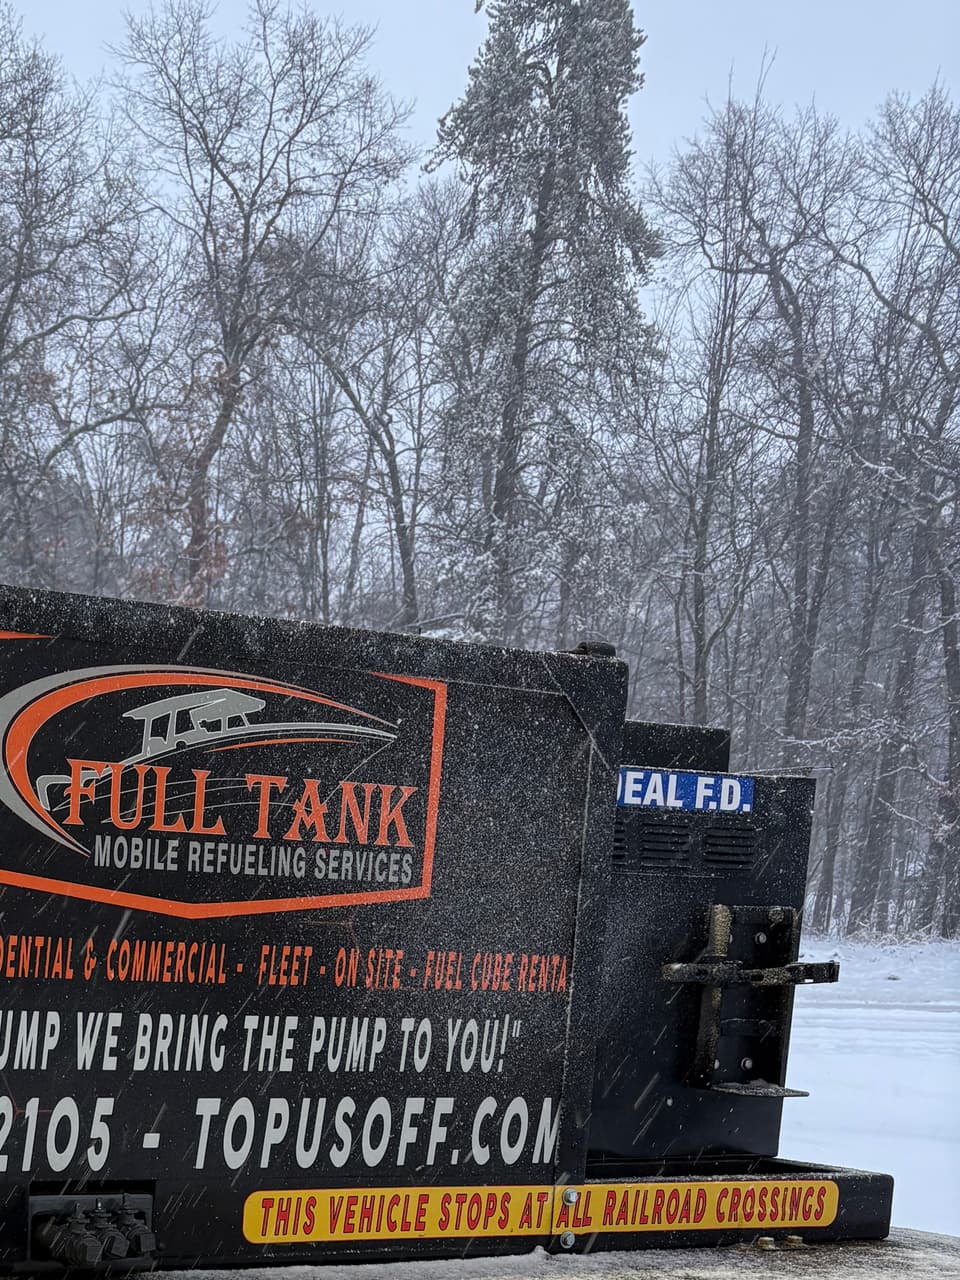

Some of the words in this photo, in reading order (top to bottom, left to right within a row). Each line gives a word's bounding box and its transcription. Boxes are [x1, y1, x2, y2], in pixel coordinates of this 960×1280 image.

[63, 758, 227, 836] FULL
[245, 773, 418, 848] TANK
[617, 771, 683, 808] EAL
[695, 776, 751, 812] F.D.
[93, 834, 179, 872] MOBILE
[187, 840, 306, 879] REFUELING
[314, 849, 413, 884] SERVICES
[83, 938, 97, 981] &
[106, 937, 227, 984] COMMERCIAL
[258, 944, 313, 987] FLEET
[334, 949, 360, 987] ON
[367, 948, 403, 990] SITE
[423, 951, 462, 992] FUEL
[471, 952, 513, 991] CUBE
[76, 1012, 123, 1071] WE
[133, 1013, 228, 1073] BRING
[242, 1015, 299, 1072] THE
[307, 1016, 387, 1073] PUMP
[400, 1017, 432, 1073] TO
[445, 1014, 521, 1073] YOU!"
[194, 1096, 561, 1169] TOPUSOFF.COM
[261, 1195, 317, 1237] THIS
[329, 1194, 429, 1233] VEHICLE
[440, 1192, 512, 1231] STOPS
[519, 1191, 548, 1230] AT
[556, 1190, 592, 1228] ALL
[602, 1188, 707, 1226] RAILROAD
[716, 1185, 827, 1222] CROSSINGS
